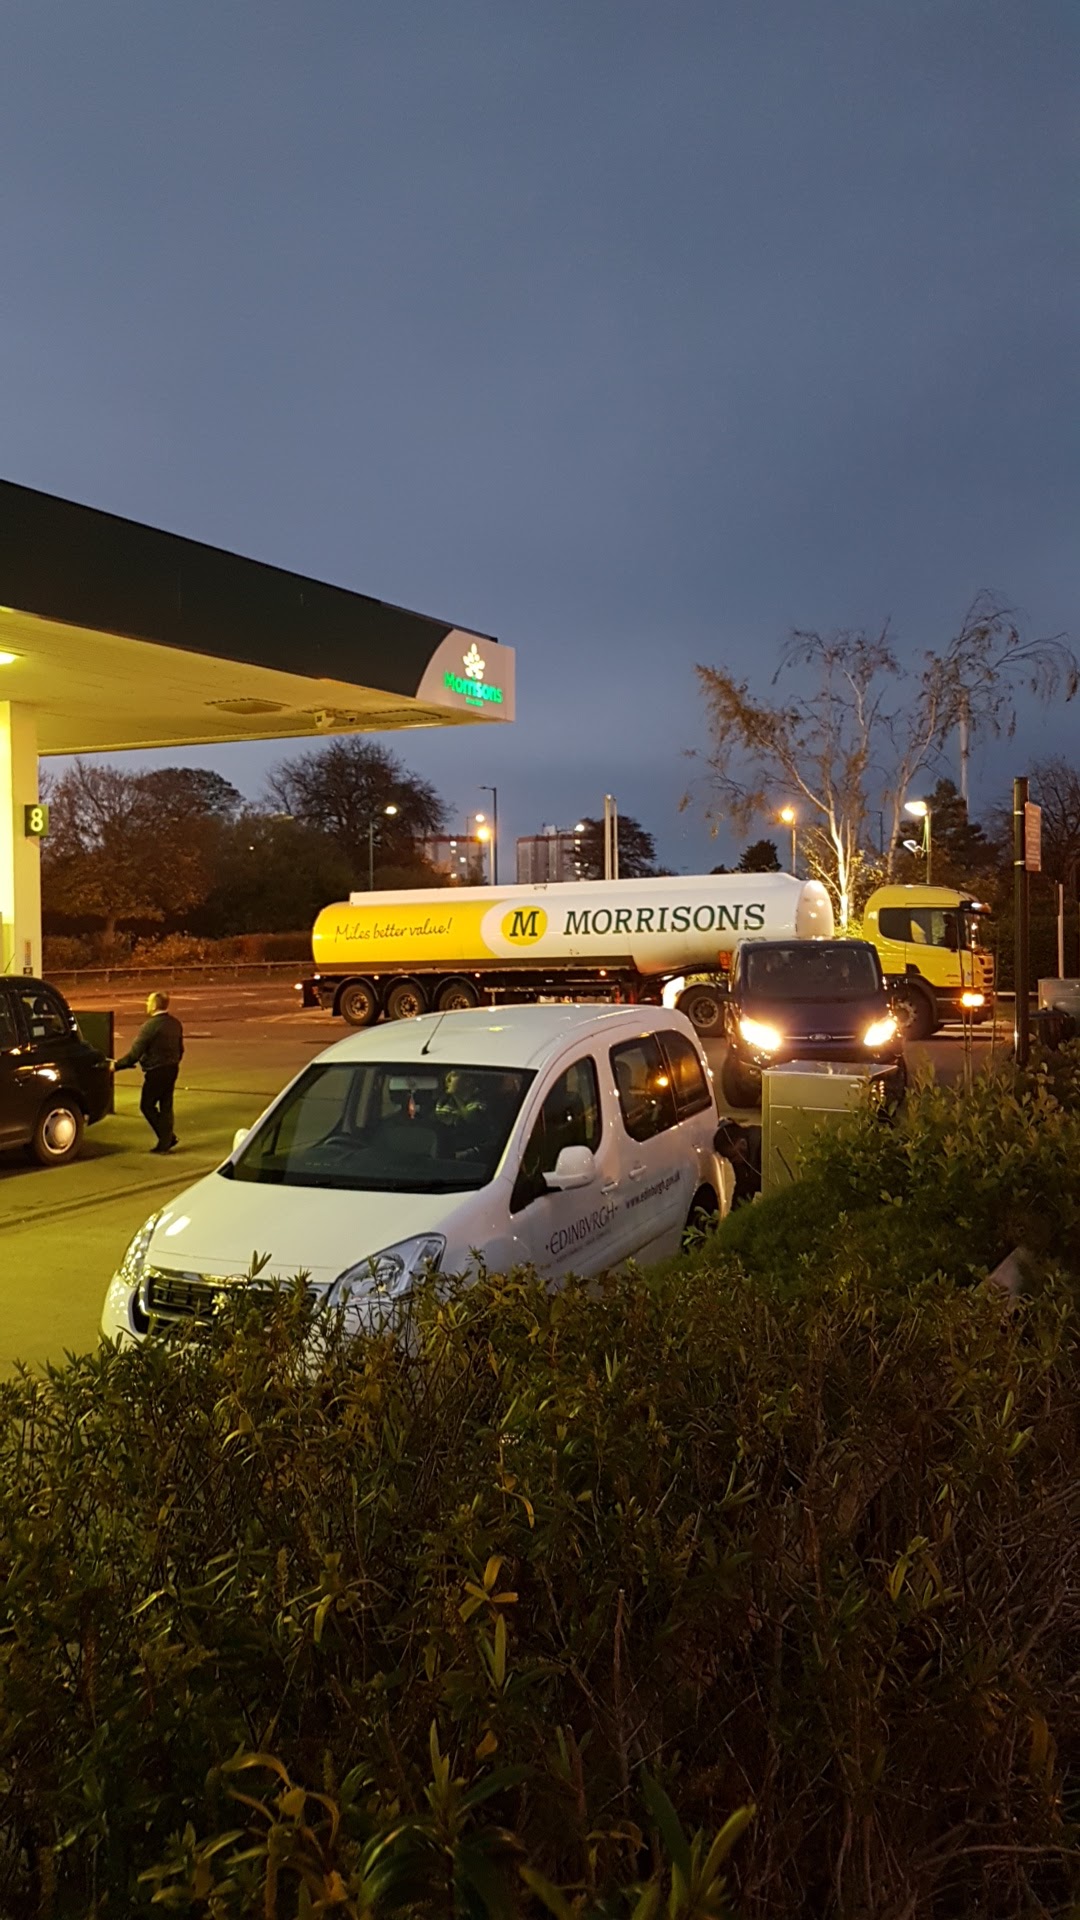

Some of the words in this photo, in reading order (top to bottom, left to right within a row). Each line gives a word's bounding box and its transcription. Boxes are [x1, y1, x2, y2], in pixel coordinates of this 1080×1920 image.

[444, 671, 503, 704] Morrisons
[30, 808, 44, 832] 8
[334, 922, 371, 943] Miles
[373, 922, 407, 939] better
[409, 917, 453, 936] value!
[509, 910, 540, 937] M
[563, 903, 766, 936] MORRISONS
